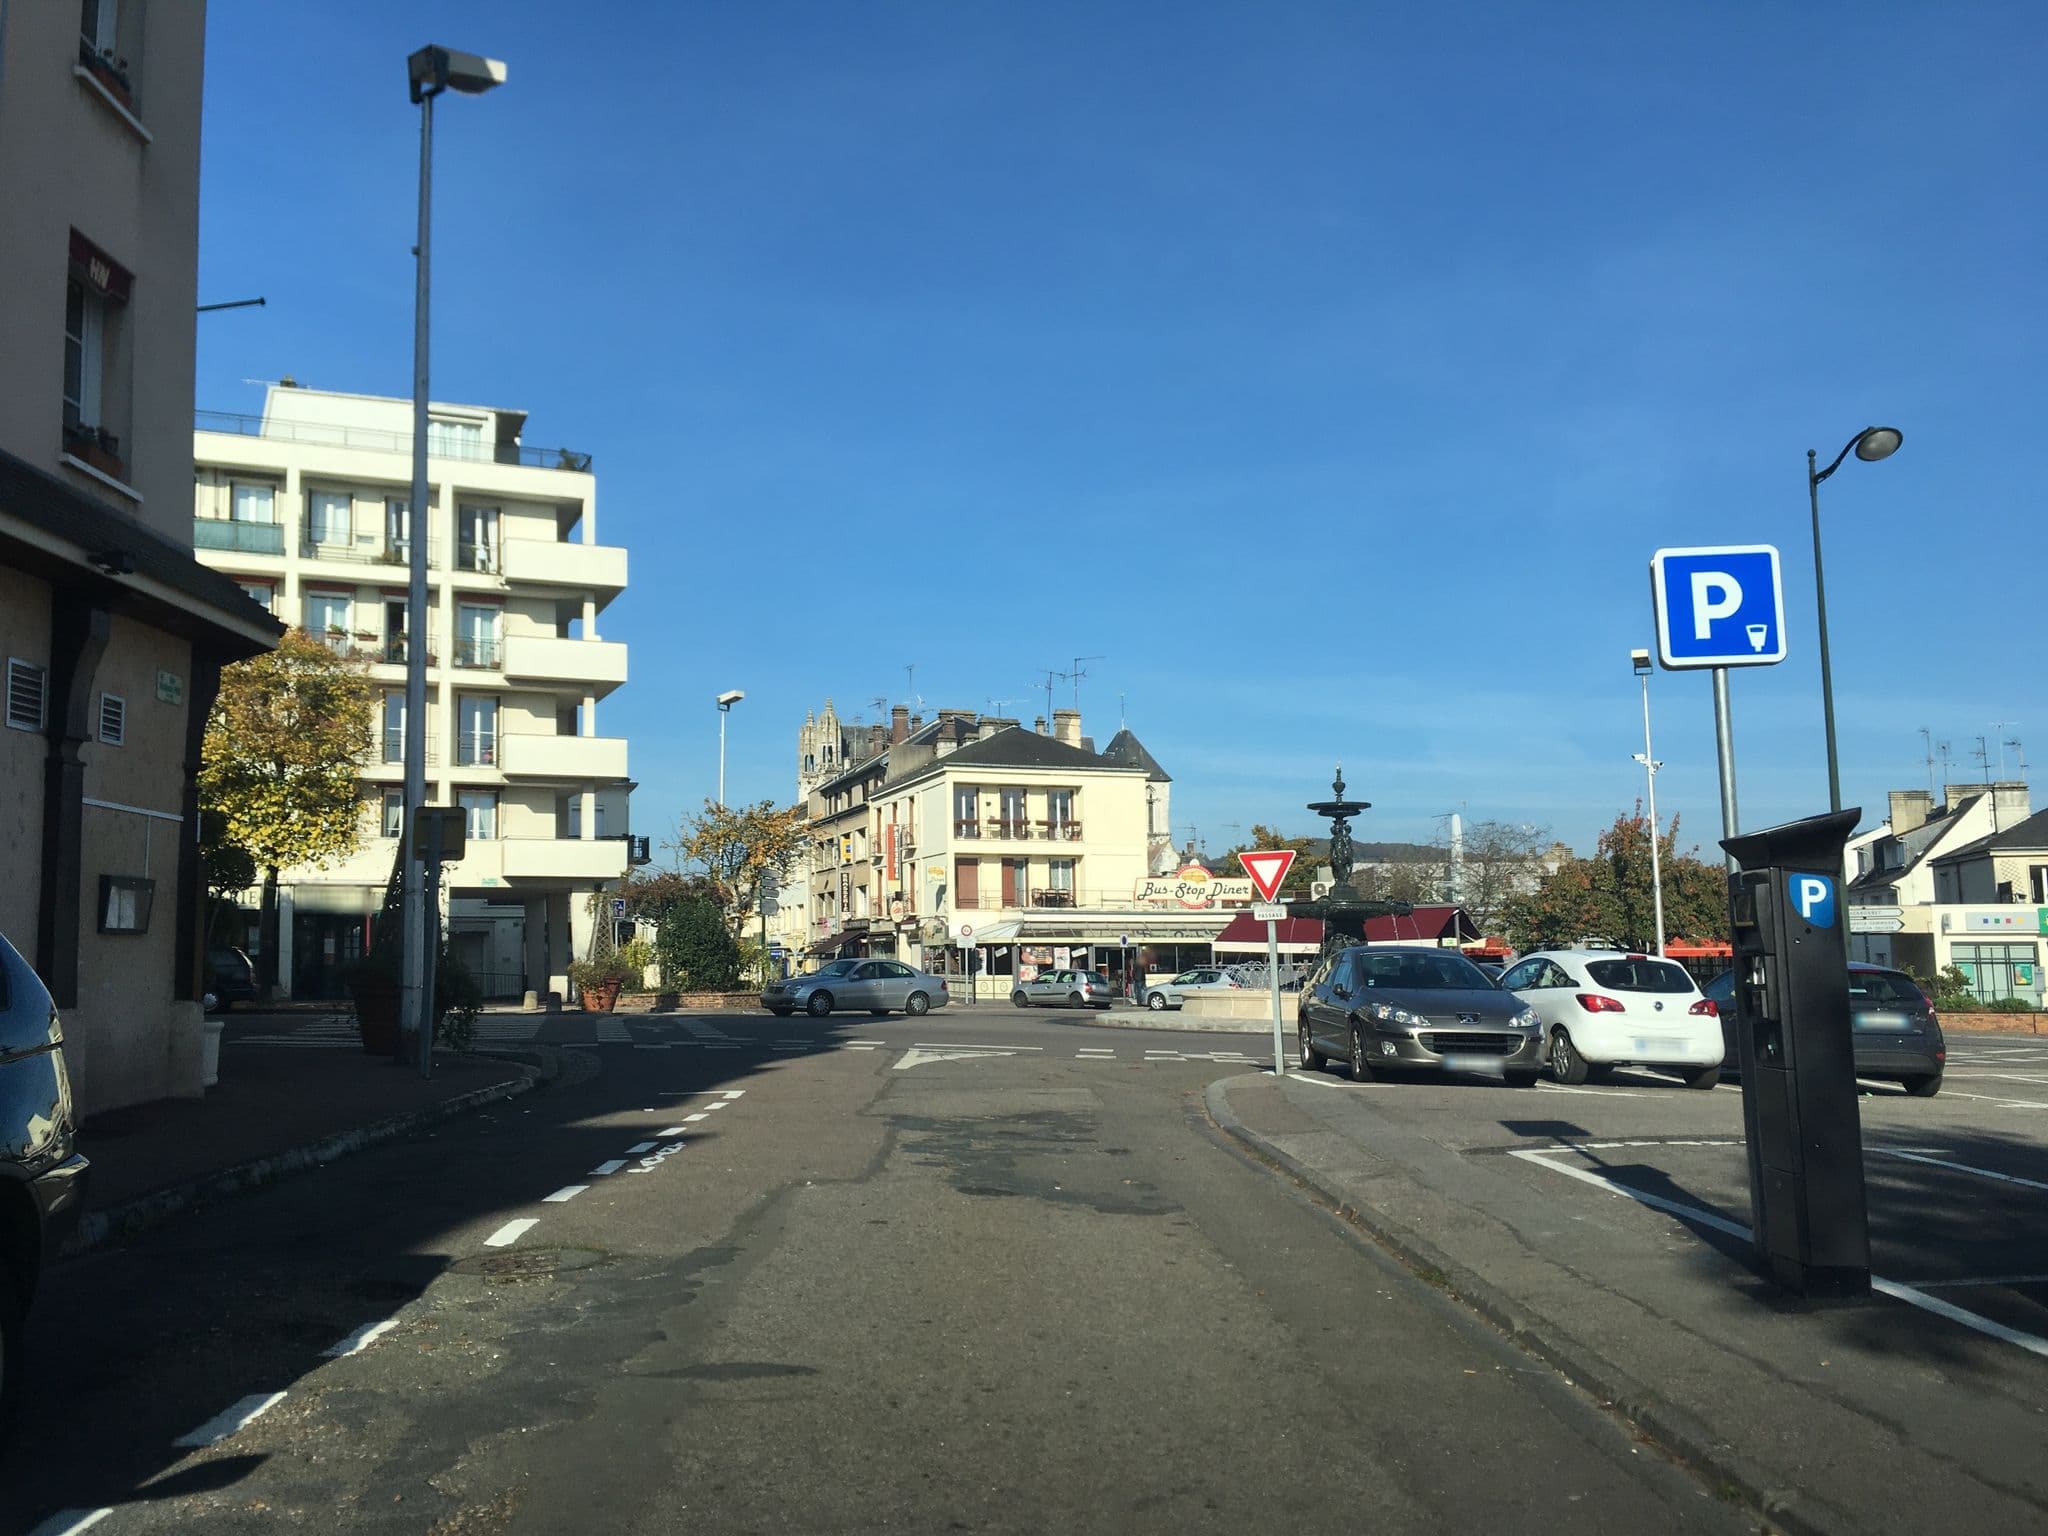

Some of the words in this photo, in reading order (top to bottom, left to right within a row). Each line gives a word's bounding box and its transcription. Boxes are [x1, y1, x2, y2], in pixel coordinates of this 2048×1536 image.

[1690, 571, 1744, 640] P
[1137, 882, 1206, 900] Bus-Stop
[1205, 882, 1249, 900] Diner
[1800, 878, 1828, 918] P
